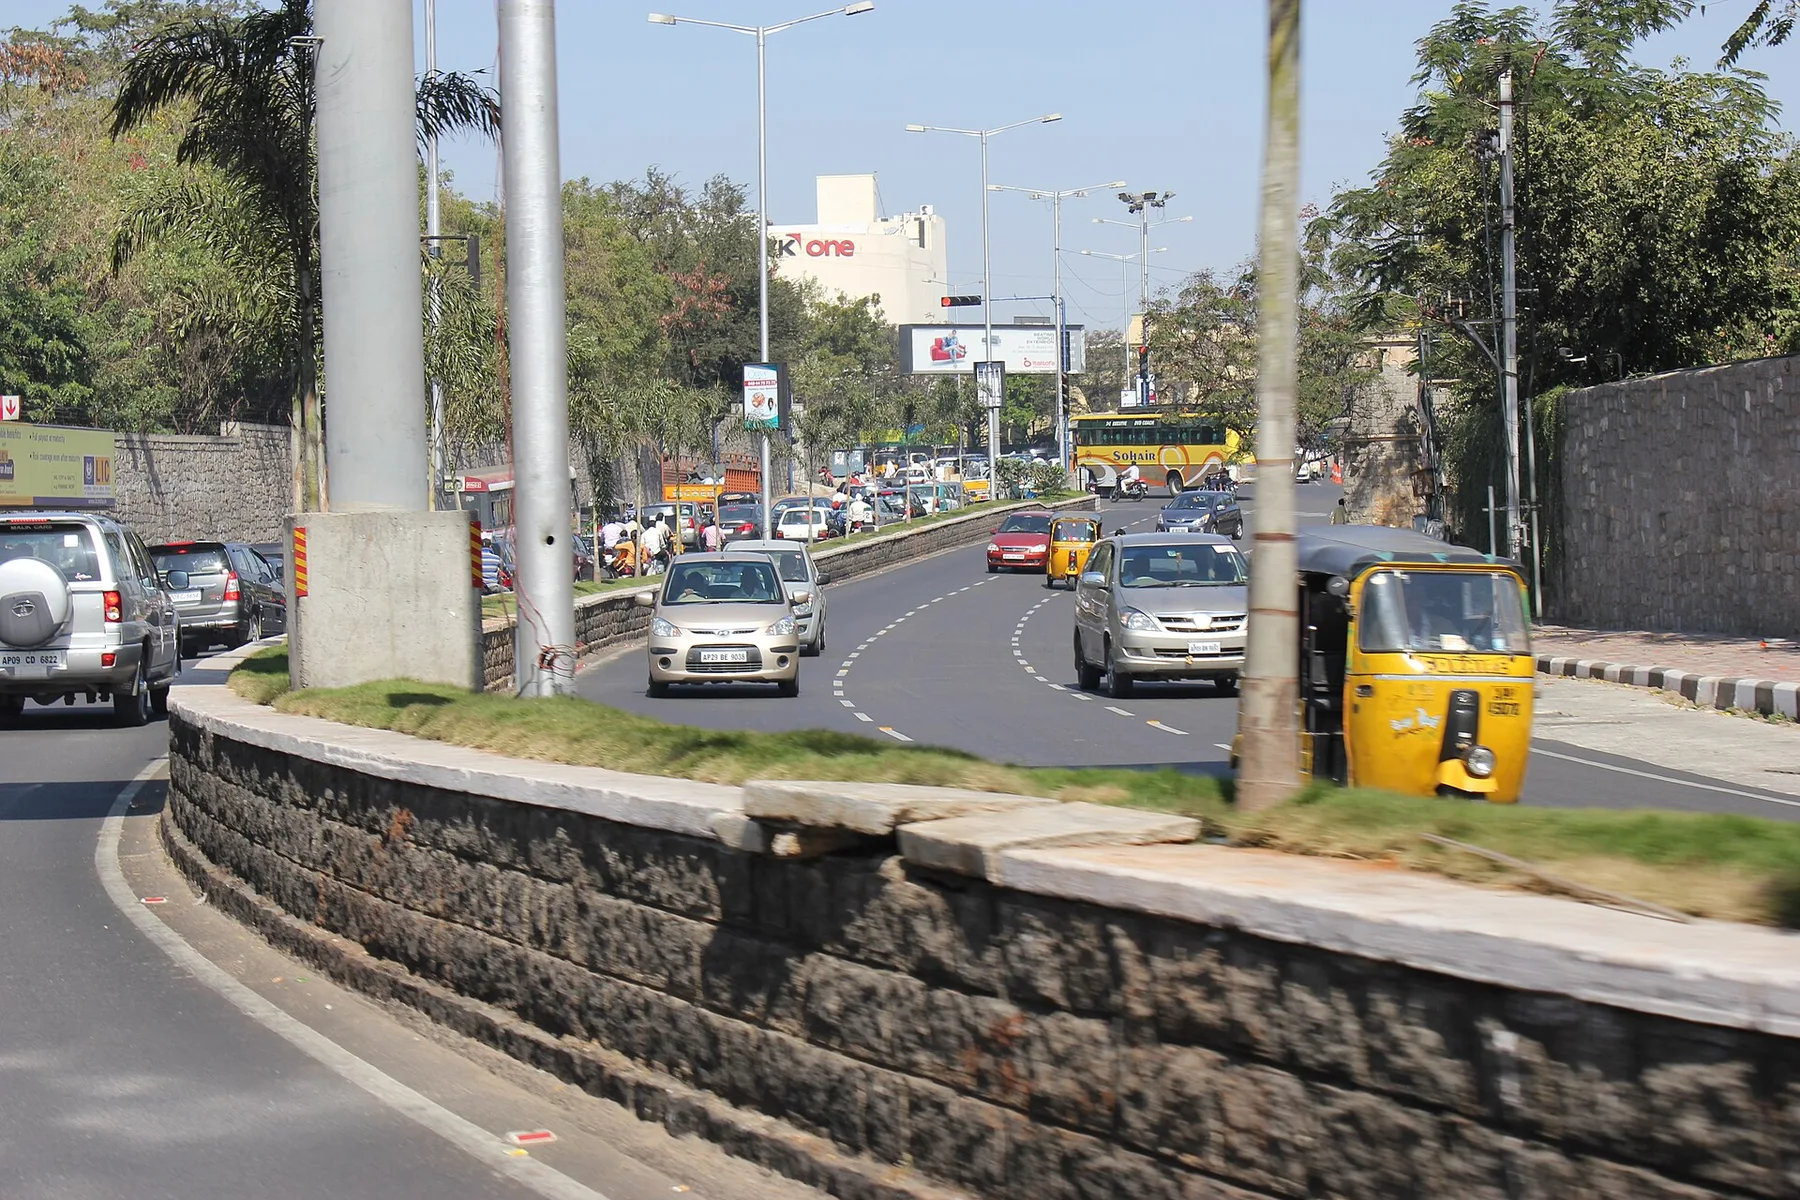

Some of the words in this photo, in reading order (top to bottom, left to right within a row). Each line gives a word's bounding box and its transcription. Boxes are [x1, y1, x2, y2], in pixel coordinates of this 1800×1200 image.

[805, 239, 855, 257] one
[95, 458, 110, 482] LIC
[2, 655, 21, 665] AP09
[25, 655, 36, 664] CD
[40, 655, 58, 664] 6822
[702, 653, 718, 661] AP29
[720, 653, 728, 661] BE
